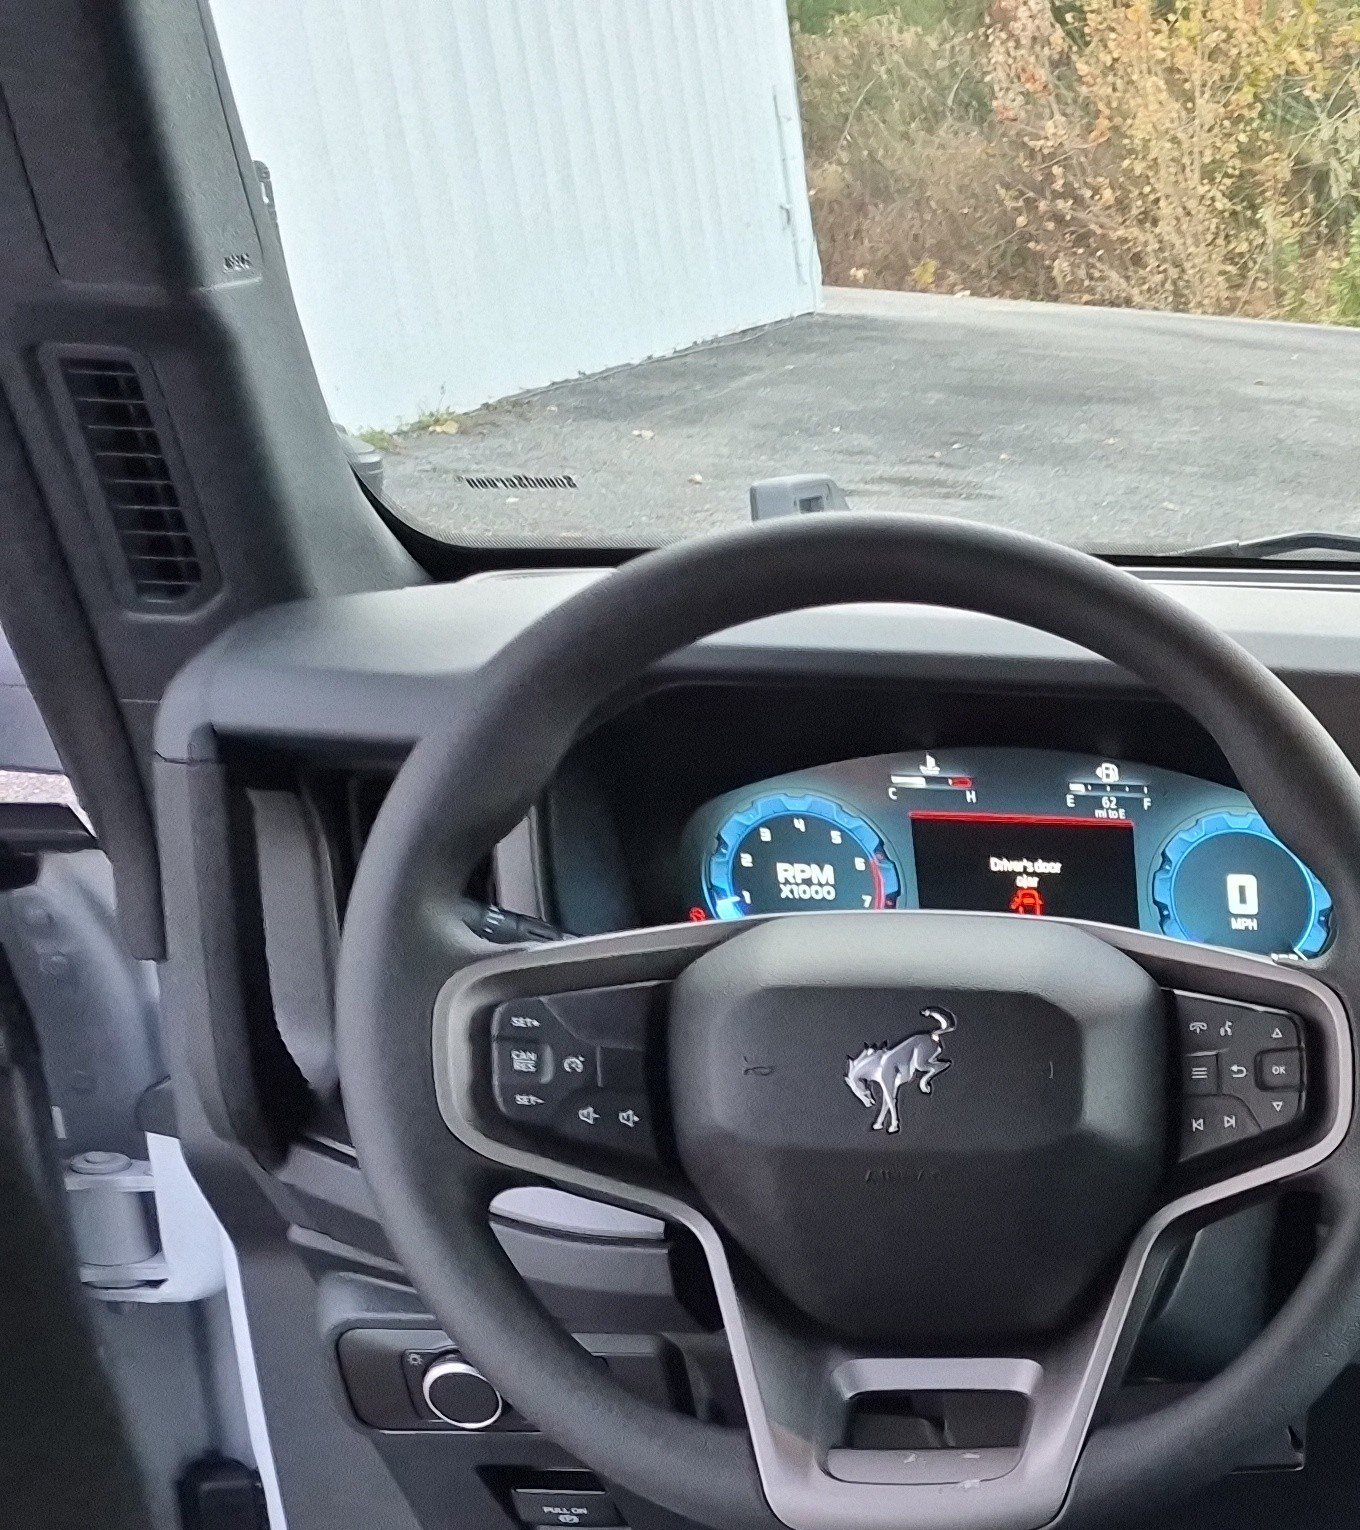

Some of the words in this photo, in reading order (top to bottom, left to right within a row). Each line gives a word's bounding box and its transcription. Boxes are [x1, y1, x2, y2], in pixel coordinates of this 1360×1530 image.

[888, 787, 898, 800] C
[966, 790, 977, 803] H
[1066, 794, 1075, 808] E
[1101, 796, 1117, 809] 62
[1143, 797, 1152, 810] F
[793, 817, 806, 832] 4
[759, 827, 772, 842] 3
[830, 830, 842, 844] 5
[740, 852, 754, 867] 2
[854, 857, 866, 871] 6
[776, 862, 836, 885] RPM
[742, 890, 752, 904] 1
[780, 884, 836, 901] X1000
[1226, 873, 1259, 915] 0
[861, 895, 872, 908] 7
[1230, 917, 1258, 931] MPH
[1271, 1065, 1286, 1075] OK
